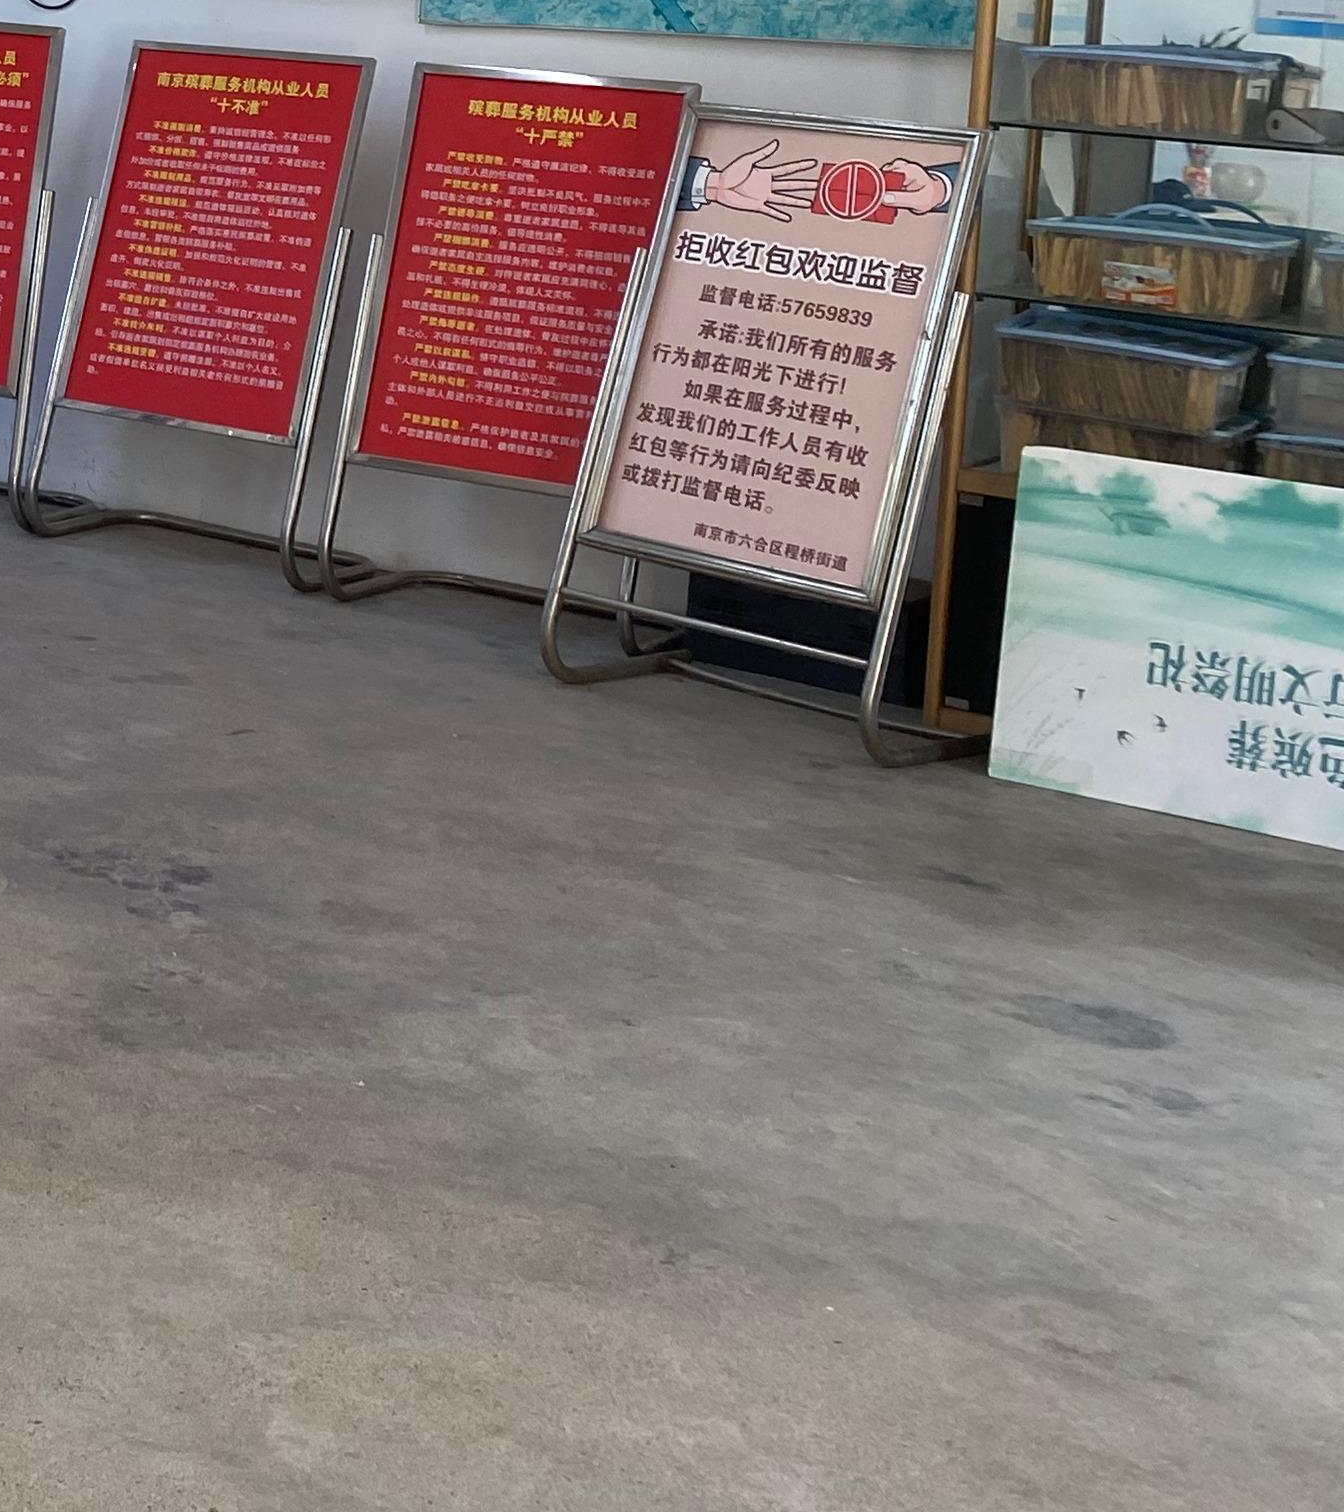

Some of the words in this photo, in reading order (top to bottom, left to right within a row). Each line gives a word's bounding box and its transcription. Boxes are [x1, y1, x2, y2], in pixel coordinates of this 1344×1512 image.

[155, 69, 331, 100] 南京殡葬服务机构从业人员
[208, 96, 268, 116] “十不准”
[466, 98, 641, 130] 殡葬服务机构从业人员
[513, 126, 584, 149] “十严禁”
[675, 231, 926, 296] 拒收红包欢迎监督
[698, 284, 873, 327] 监督电话:57659839
[652, 342, 847, 395] 行为都在阳光下进行!
[697, 319, 898, 373] 承诺:我们所有的服务
[683, 379, 861, 434] 如果在服务过程中,
[636, 402, 869, 467] 发现我们的工作人员有收
[622, 463, 773, 515] 或拨打监督电话。
[628, 433, 860, 499] 红包等行为请向纪委反映
[693, 523, 848, 572] 南京市六合区程桥街道
